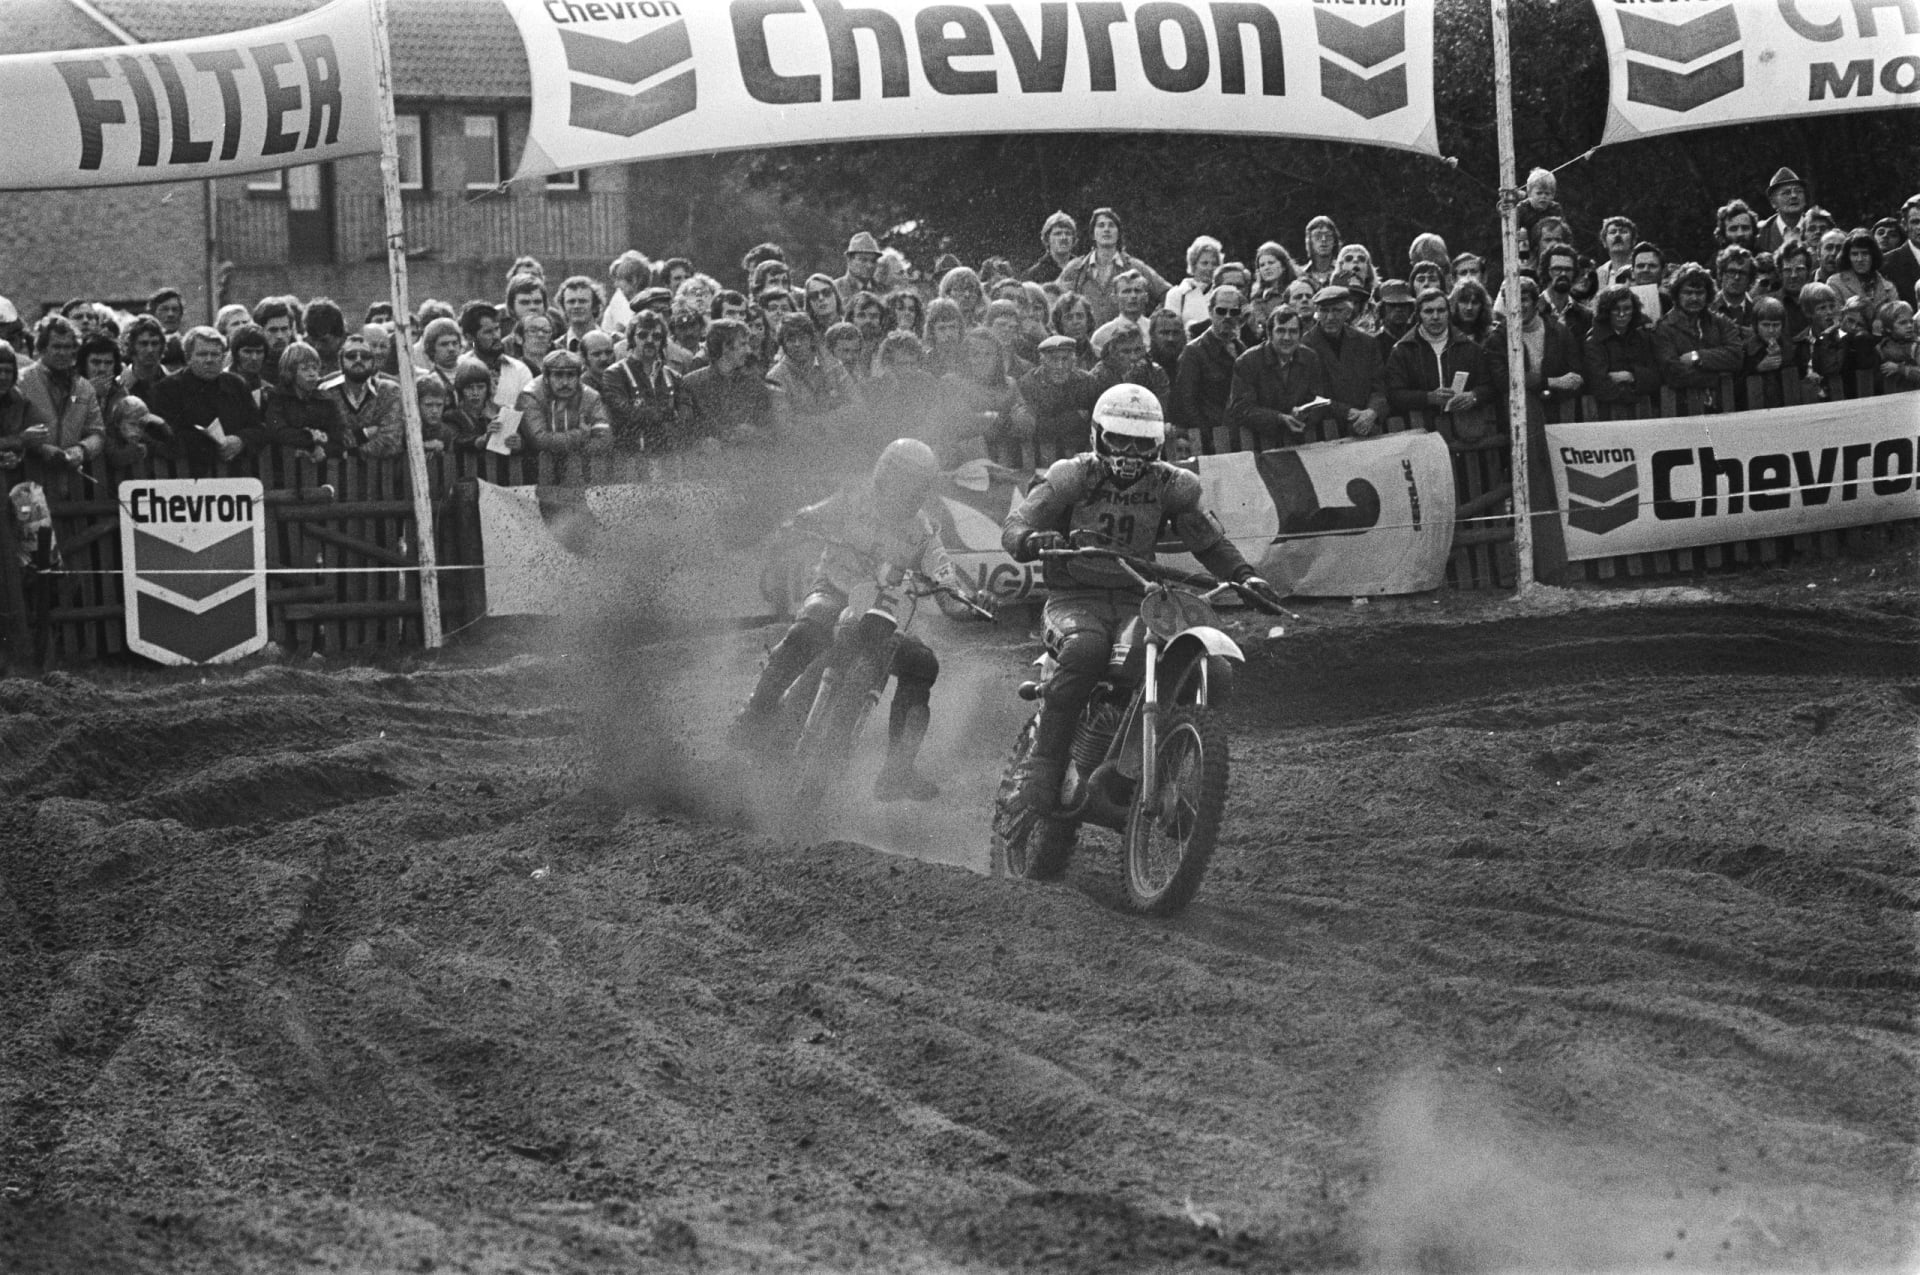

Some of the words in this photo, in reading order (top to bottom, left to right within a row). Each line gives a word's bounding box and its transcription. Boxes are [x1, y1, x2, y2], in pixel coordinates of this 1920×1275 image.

[543, 0, 682, 23] Chevron
[729, 0, 1287, 104] Chevron
[54, 34, 343, 170] FILTER
[1560, 447, 1635, 465] Chevron
[1651, 436, 1920, 521] Chevro
[131, 488, 253, 523] Chevron
